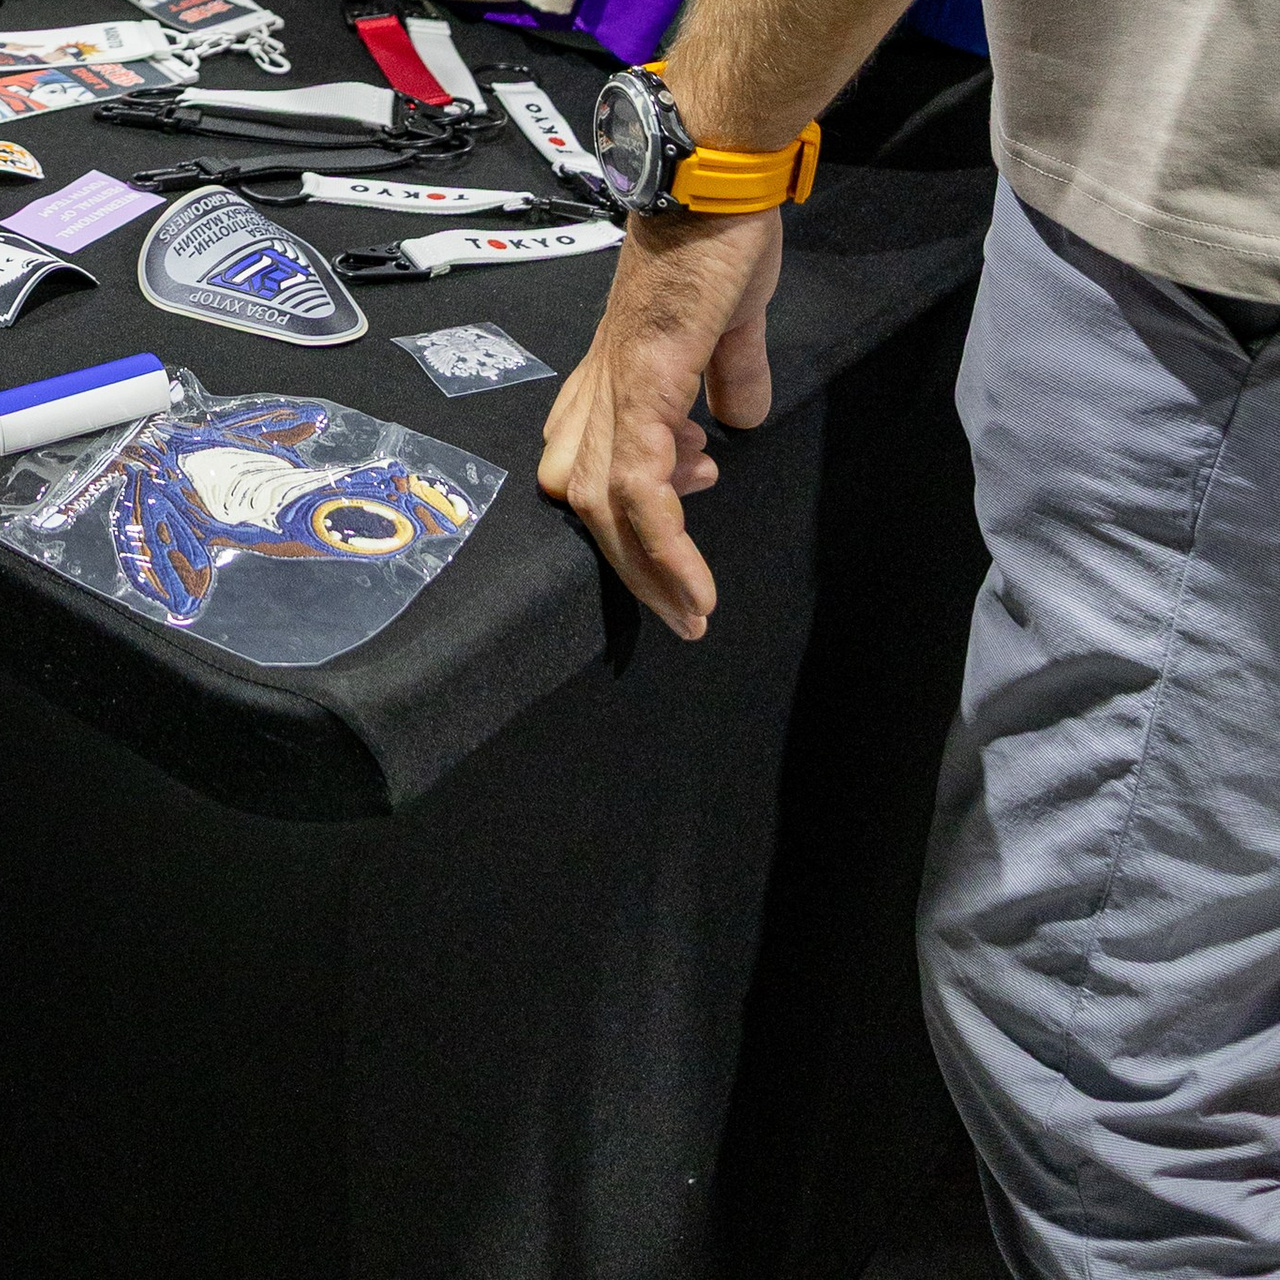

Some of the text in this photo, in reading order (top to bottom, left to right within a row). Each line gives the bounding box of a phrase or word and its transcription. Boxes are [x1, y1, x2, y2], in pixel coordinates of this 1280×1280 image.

[159, 192, 232, 243] GROOMERS
[173, 216, 220, 257] МАШИН
[189, 291, 291, 326] РОЗА ХУТОР
